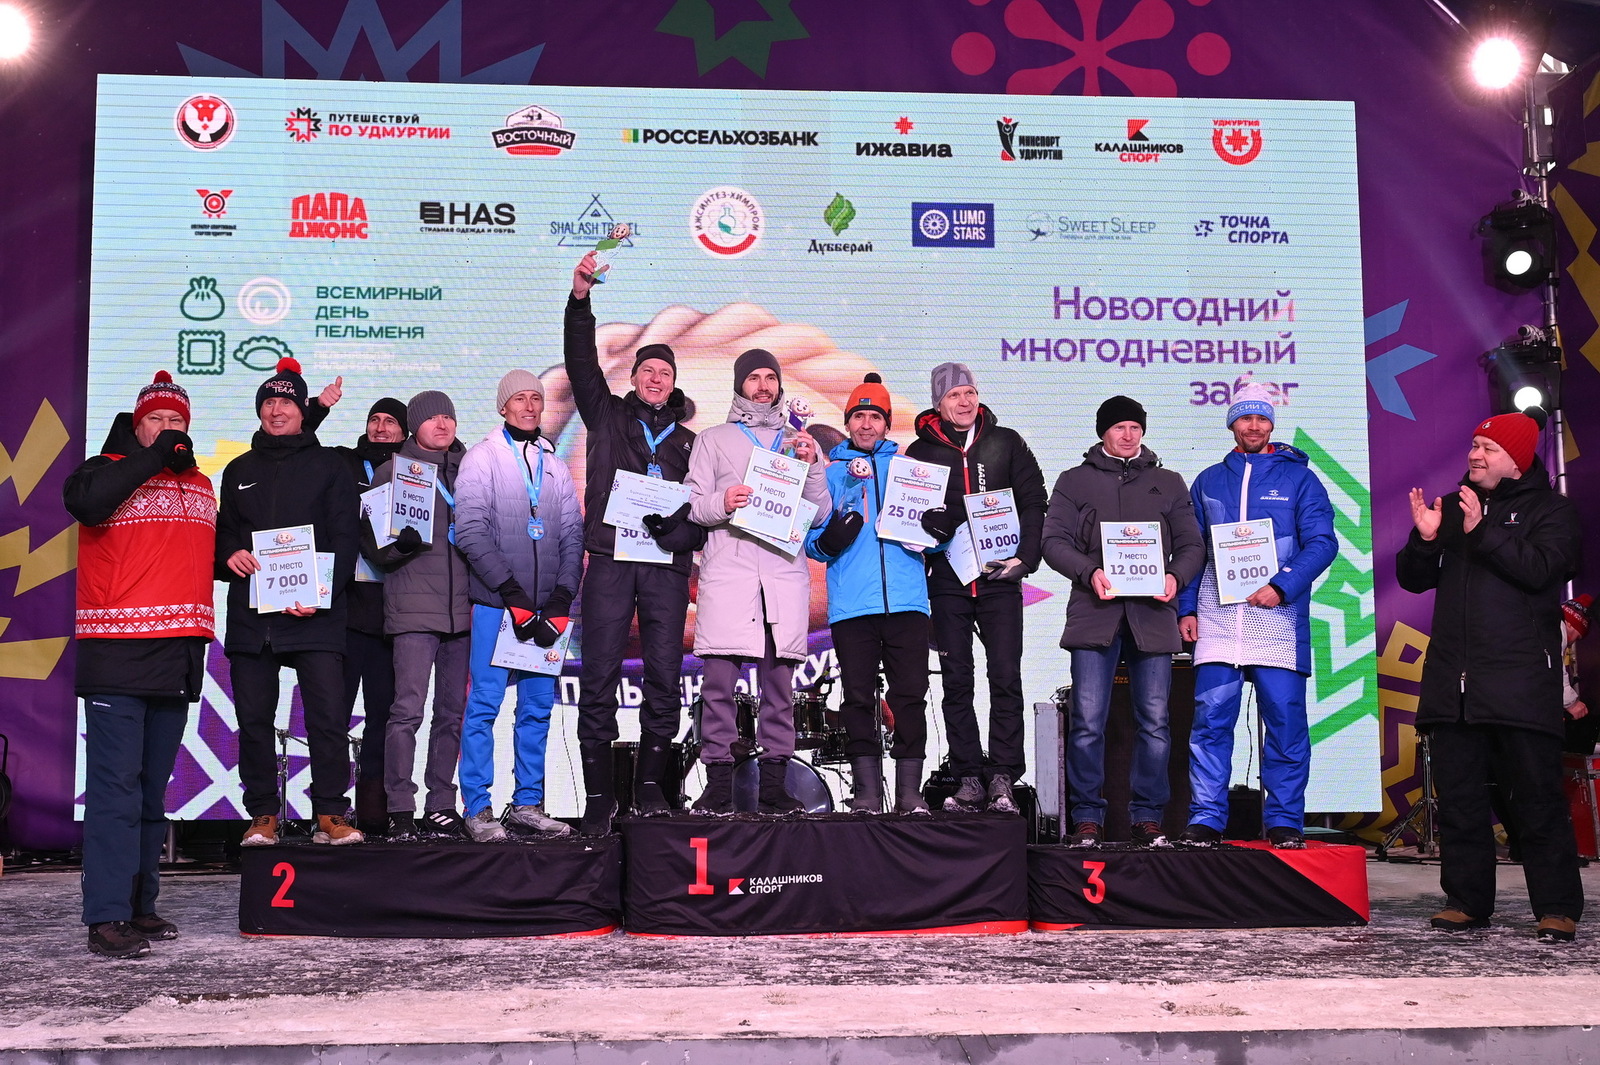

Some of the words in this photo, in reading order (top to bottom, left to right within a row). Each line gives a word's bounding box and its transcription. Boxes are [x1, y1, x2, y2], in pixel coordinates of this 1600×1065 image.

[328, 112, 420, 124] ПУТЕШЕСТВУЙ
[1212, 119, 1260, 127] УДМУРТИЯ
[328, 124, 353, 137] ПО
[358, 125, 451, 140] УДМУРТИИ
[496, 130, 571, 146] ВОСТОЧНЫЙ
[642, 129, 819, 147] РОССЕЛЬХОЗБАНК
[1018, 135, 1061, 147] МИНСПОРТ
[1095, 142, 1184, 154] КАЛАШНИКОВ
[1019, 149, 1063, 161] УДМУРТИИ
[1119, 152, 1160, 163] СПОРТ
[291, 192, 368, 221] ПАПА
[694, 191, 760, 232] ИЖСИНТЕЗ-ХИМПРОМ
[953, 210, 985, 225] LUMO
[1219, 215, 1270, 229] ТОЧКА
[289, 221, 368, 240] ДЖОНС
[550, 221, 598, 235] SHALASH
[953, 227, 986, 241] STARS
[1228, 230, 1289, 245] СПОРТА
[316, 285, 442, 301] ВСЕМИРНЫЙ
[315, 305, 369, 320] ДЕНЬ
[1053, 286, 1295, 326] Новогодний
[315, 325, 424, 339] ПЕЛЬМЕНЯ
[1001, 331, 1296, 367] многодневный
[272, 386, 297, 396] TEAM
[402, 490, 407, 499] 6
[407, 493, 425, 503] место
[759, 483, 763, 491] 1
[763, 486, 786, 499] место
[746, 494, 762, 508] 50
[765, 500, 792, 517] 000
[900, 493, 906, 501] 3
[907, 495, 929, 506] место
[394, 502, 407, 515] 15
[409, 506, 430, 522] 000
[888, 504, 905, 518] 25
[533, 528, 539, 537] 2
[620, 528, 638, 538] 30
[983, 525, 988, 533] 5
[989, 523, 1008, 532] место
[979, 538, 993, 550] 18
[995, 533, 1019, 547] 000
[1118, 552, 1123, 560] 7
[1230, 555, 1235, 564] 9
[1237, 554, 1261, 563] место
[269, 563, 277, 572] 10
[279, 561, 303, 571] место
[1110, 564, 1125, 575] 12
[1129, 564, 1158, 575] 000
[1227, 569, 1236, 581] 8
[1240, 565, 1269, 579] 000
[266, 577, 275, 589] 7
[278, 573, 308, 588] 000
[688, 837, 715, 895] 1
[270, 862, 296, 908] 2
[749, 874, 823, 886] КАЛАШНИКОВ
[1082, 860, 1106, 904] 3
[749, 884, 783, 895] СПОРТ
